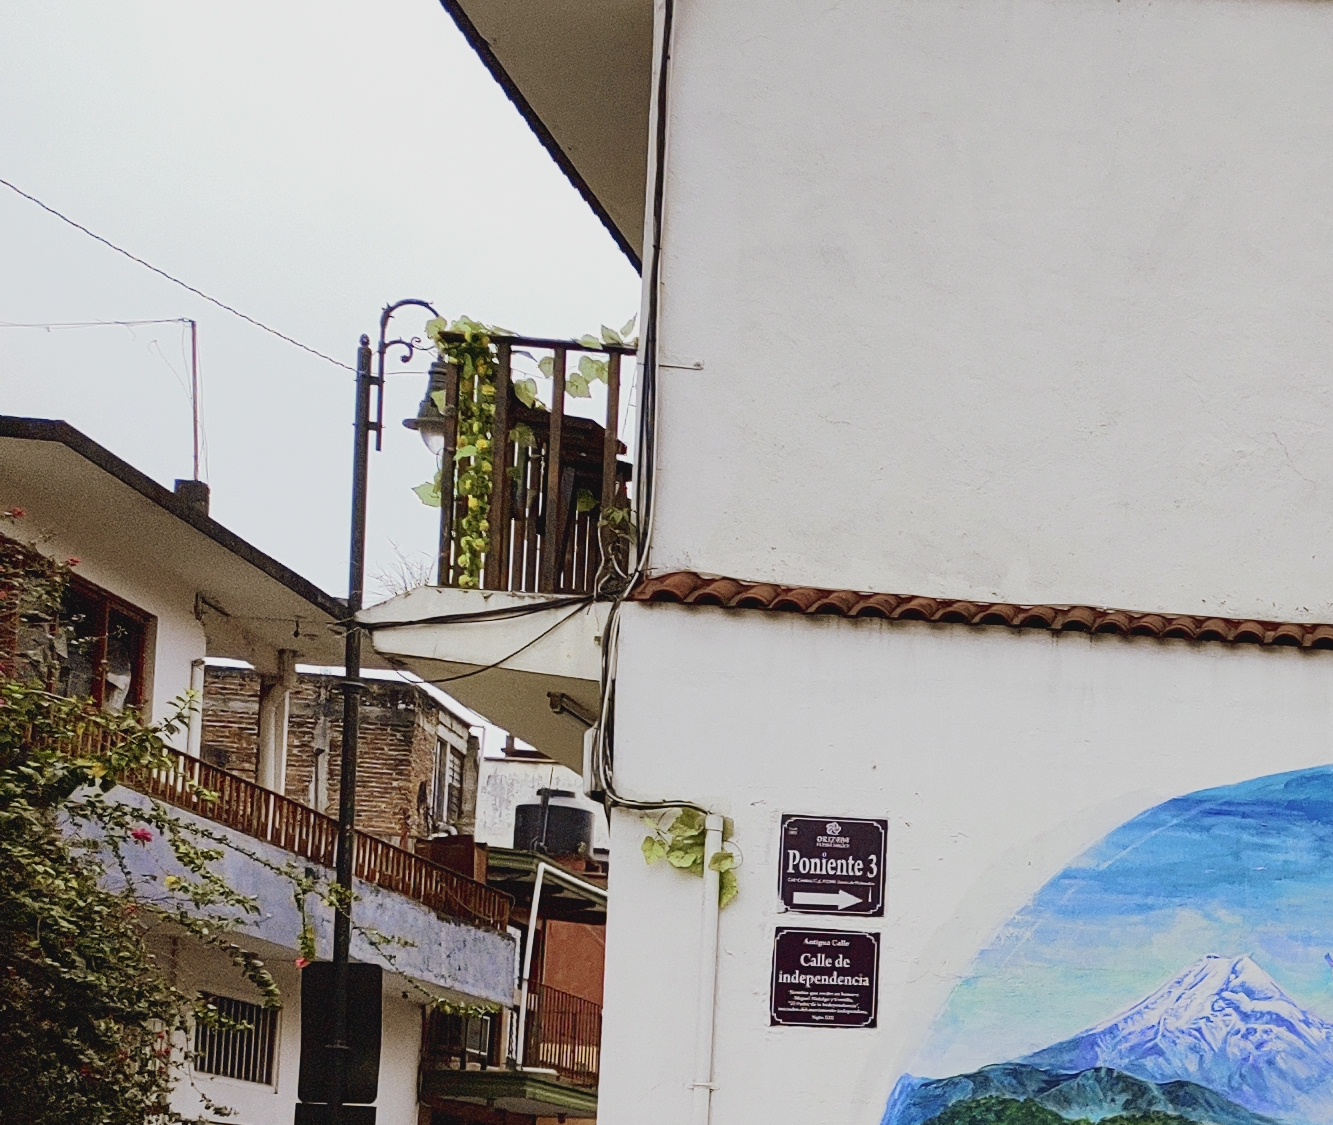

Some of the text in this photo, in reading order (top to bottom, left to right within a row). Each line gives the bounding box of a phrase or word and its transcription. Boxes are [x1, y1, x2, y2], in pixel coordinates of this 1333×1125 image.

[786, 849, 878, 878] Poniente 3
[831, 939, 851, 947] Calle
[800, 953, 851, 968] Calle de
[778, 970, 870, 989] independencia
